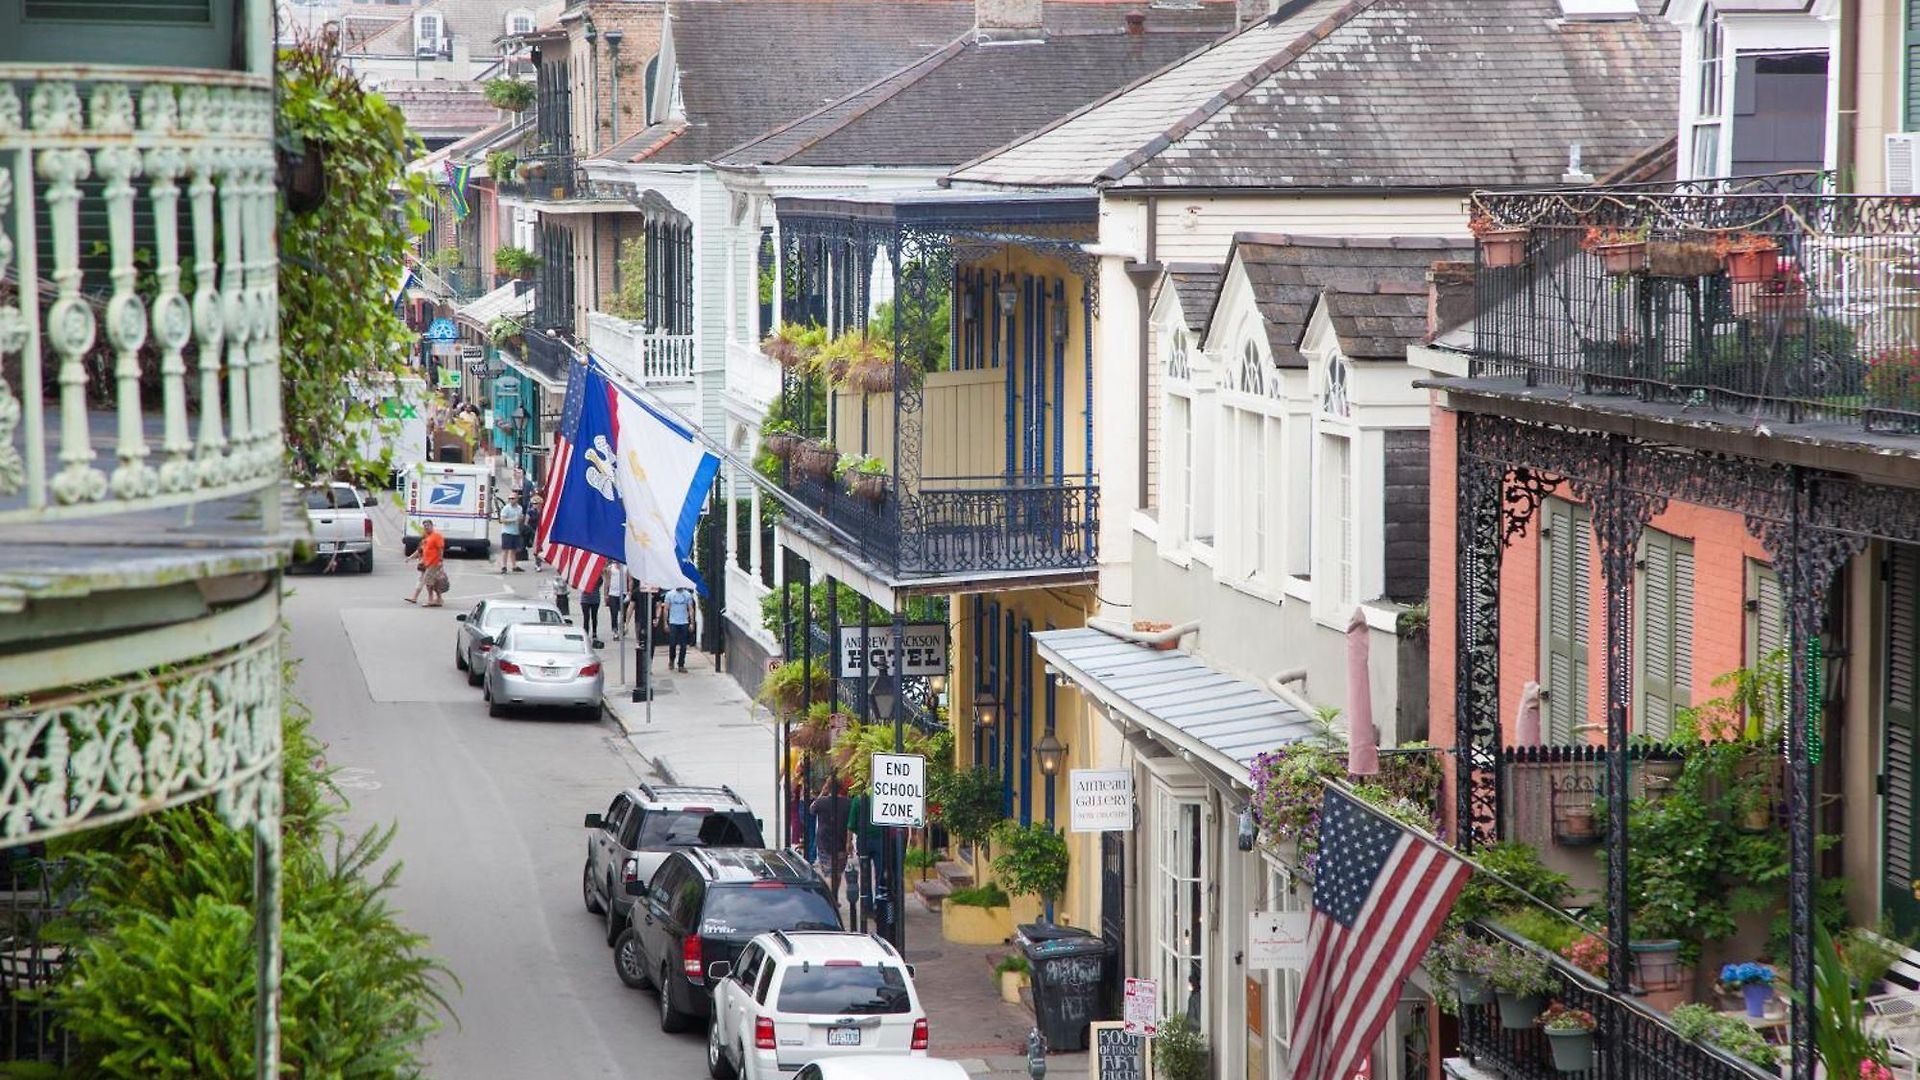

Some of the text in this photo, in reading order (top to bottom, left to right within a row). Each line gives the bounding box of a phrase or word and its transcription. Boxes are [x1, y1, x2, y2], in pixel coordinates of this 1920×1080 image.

[845, 634, 940, 648] ANREW ACKSON
[886, 762, 910, 776] END
[875, 781, 921, 797] SCHOOL
[882, 803, 913, 817] ZONE
